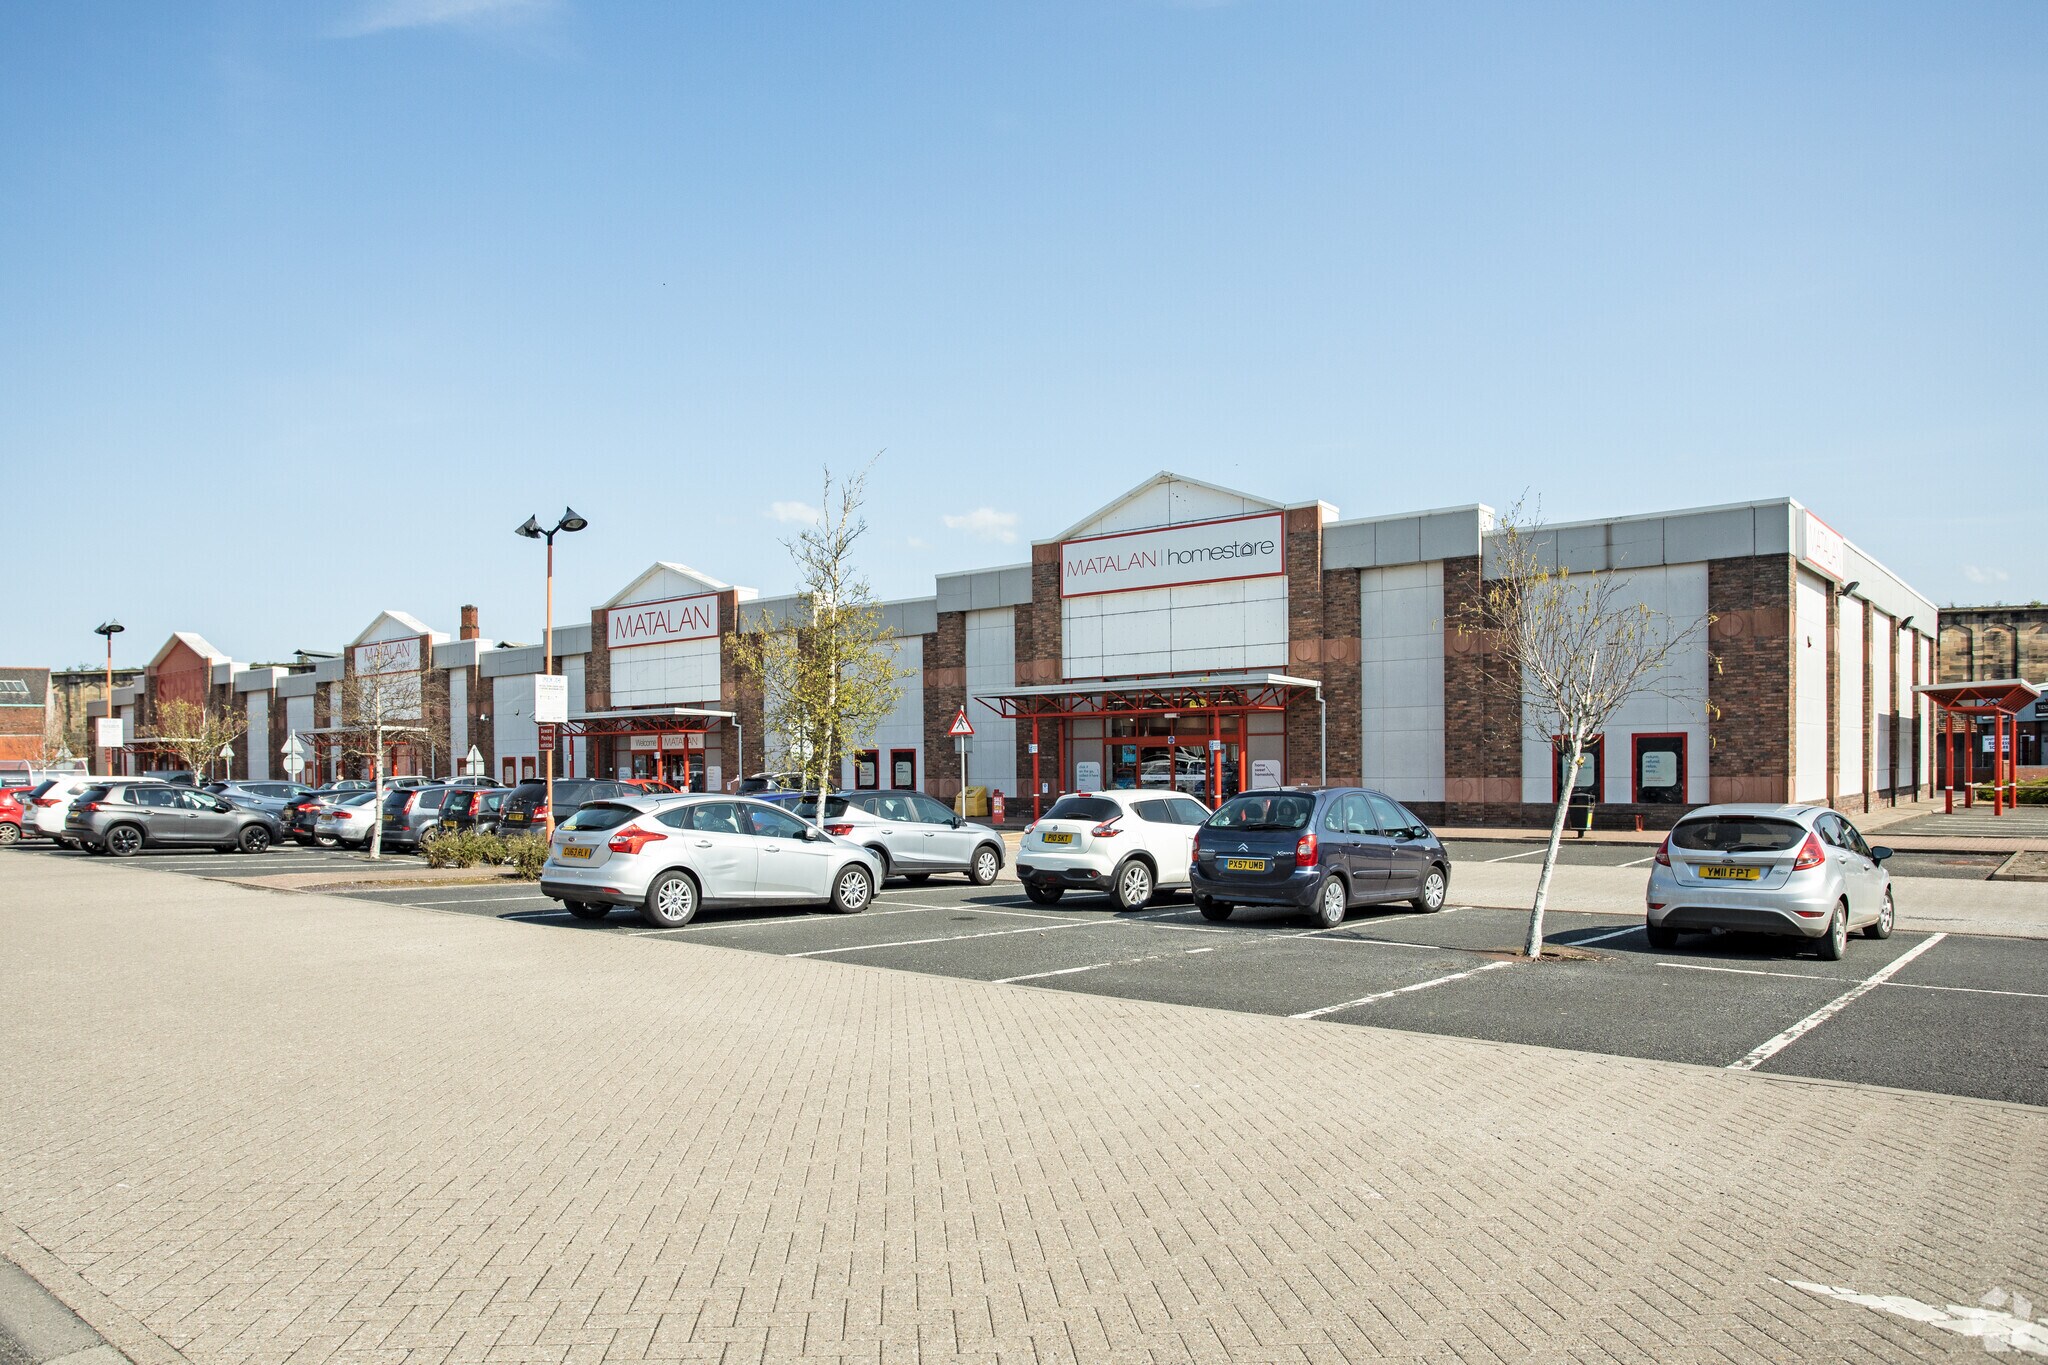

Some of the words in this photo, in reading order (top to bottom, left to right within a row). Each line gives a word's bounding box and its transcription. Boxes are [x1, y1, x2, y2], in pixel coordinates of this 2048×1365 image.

[1066, 550, 1157, 578] MATALAN
[1167, 540, 1275, 566] homestore
[615, 603, 710, 640] MATALAN
[364, 641, 411, 662] MATALAN
[635, 738, 657, 747] Welcome
[664, 736, 698, 747] MATAAN
[1057, 834, 1069, 842] SKT
[1228, 859, 1247, 868] PX57
[1248, 860, 1264, 870] UMB
[1707, 867, 1727, 877] YM11
[1728, 868, 1751, 878] FPT
